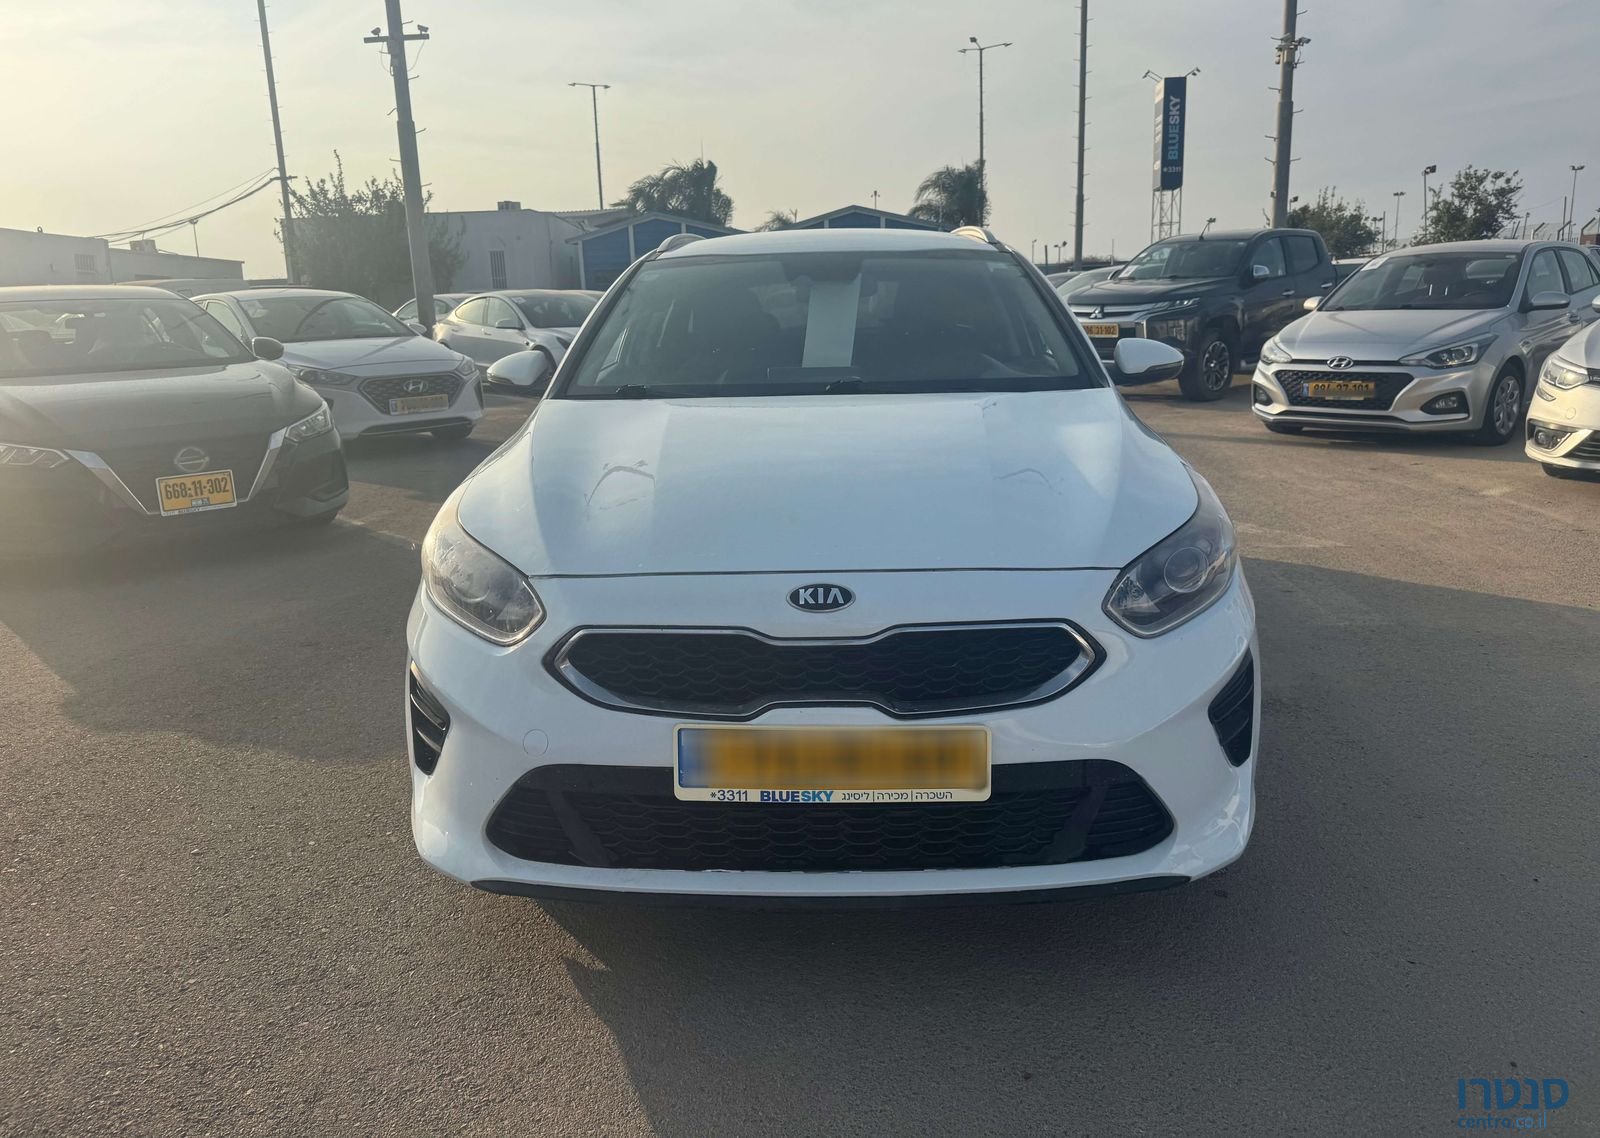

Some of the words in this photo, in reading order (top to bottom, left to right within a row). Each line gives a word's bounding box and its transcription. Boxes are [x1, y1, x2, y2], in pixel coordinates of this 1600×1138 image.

[1168, 95, 1181, 160] BLUESKY
[798, 587, 844, 605] KIA
[760, 790, 834, 802] BLUESKY
[841, 791, 870, 801] ליסינג
[876, 791, 909, 800] מכירה
[915, 791, 953, 800] השכרה
